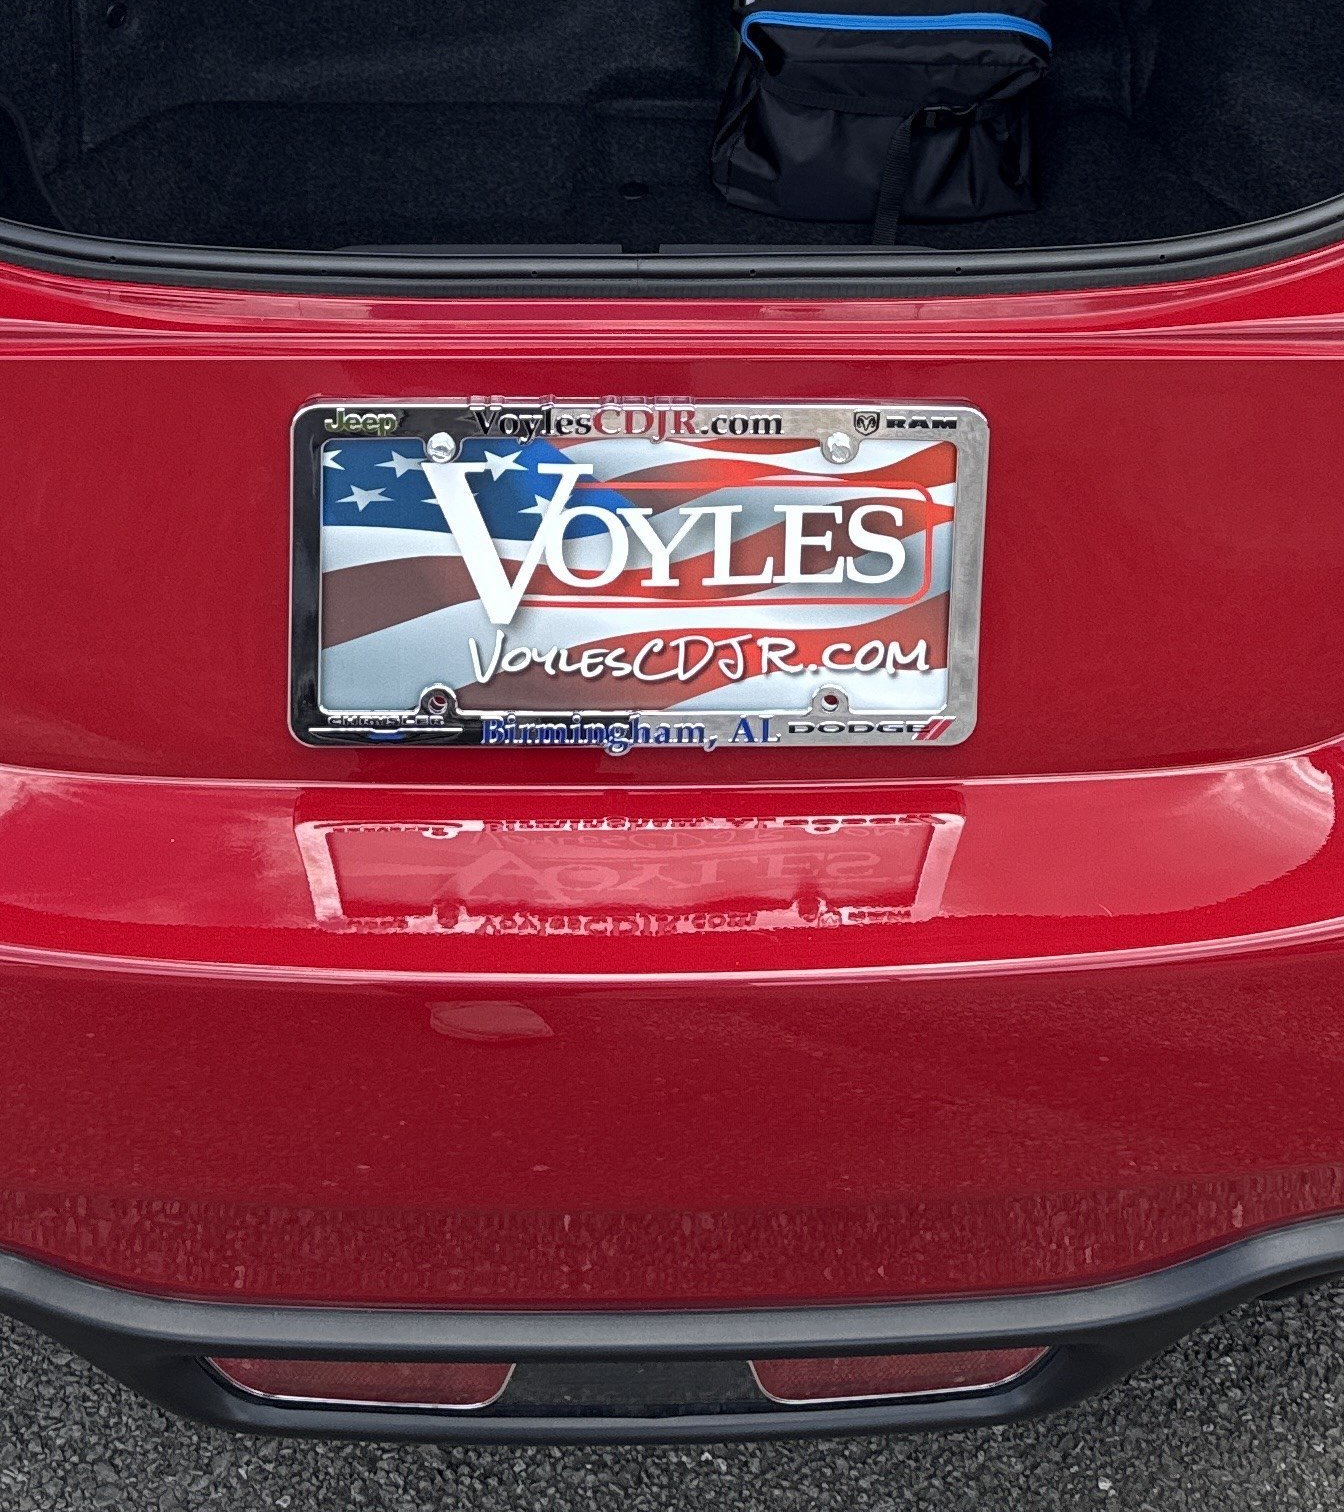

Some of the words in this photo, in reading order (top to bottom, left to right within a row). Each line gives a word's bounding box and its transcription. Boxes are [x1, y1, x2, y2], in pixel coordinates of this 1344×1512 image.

[324, 407, 398, 436] Jeep
[468, 404, 785, 445] VoylesCDJR.com
[886, 414, 958, 430] RAM
[421, 462, 907, 625] VOYLES
[326, 714, 446, 727] CHRYSLER
[480, 712, 719, 756] Birmingham,
[727, 713, 781, 745] AL
[787, 720, 934, 735] DODGE
